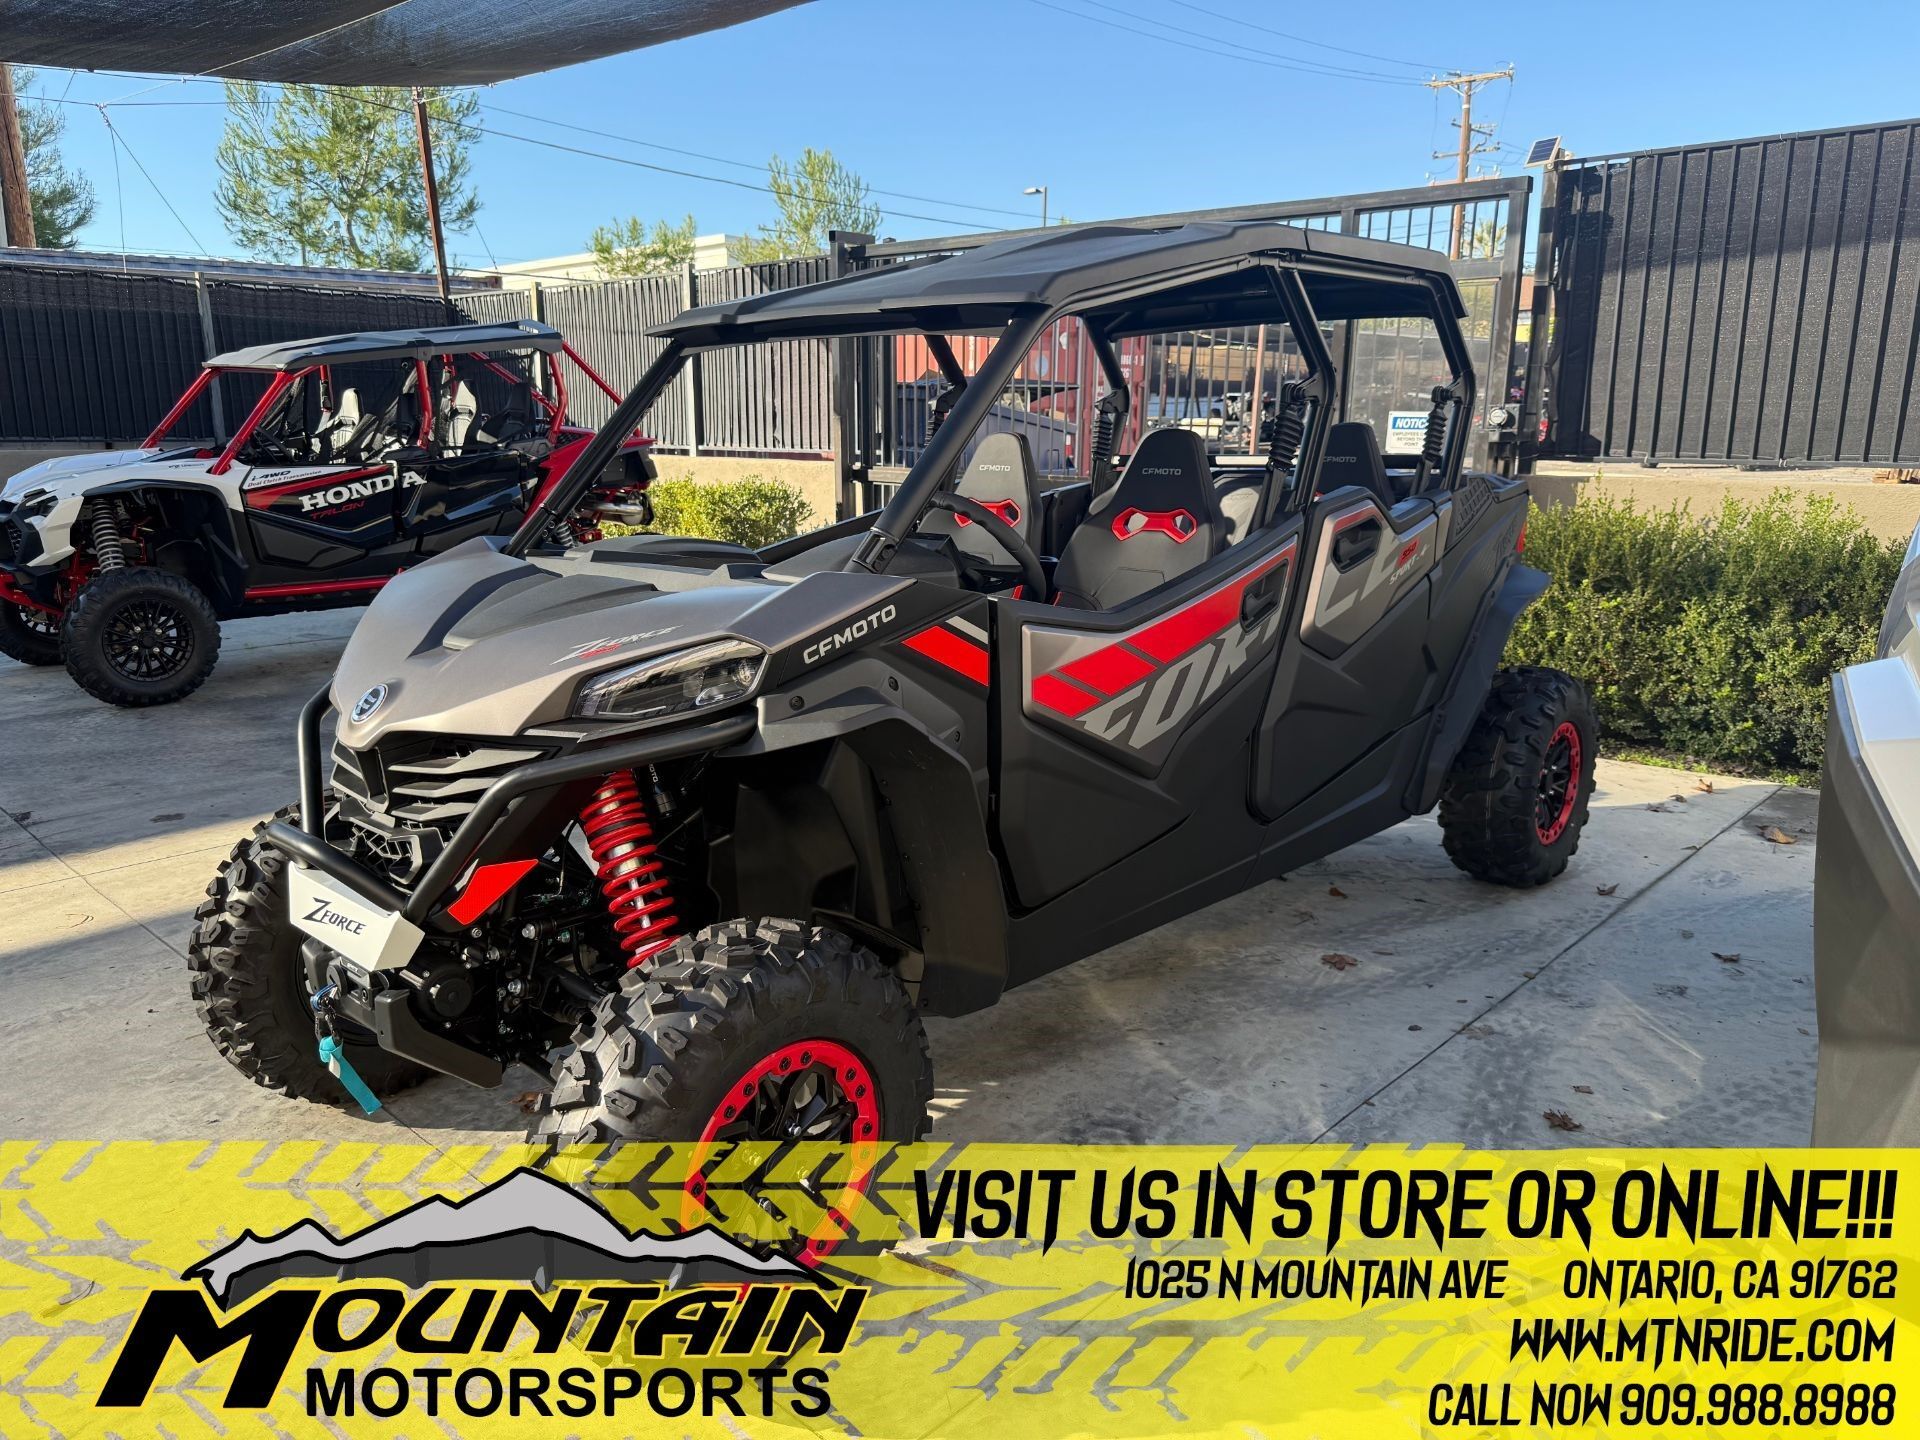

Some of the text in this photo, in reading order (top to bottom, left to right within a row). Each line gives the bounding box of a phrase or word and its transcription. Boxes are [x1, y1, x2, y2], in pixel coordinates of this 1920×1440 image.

[1395, 417, 1427, 428] NOTIC
[979, 464, 1011, 472] CFMOTO
[1142, 467, 1182, 476] CFMOTO
[298, 470, 427, 512] HONDA
[309, 501, 366, 521] TALON
[803, 604, 897, 665] CFMOTO
[301, 896, 367, 936] ZFORCE
